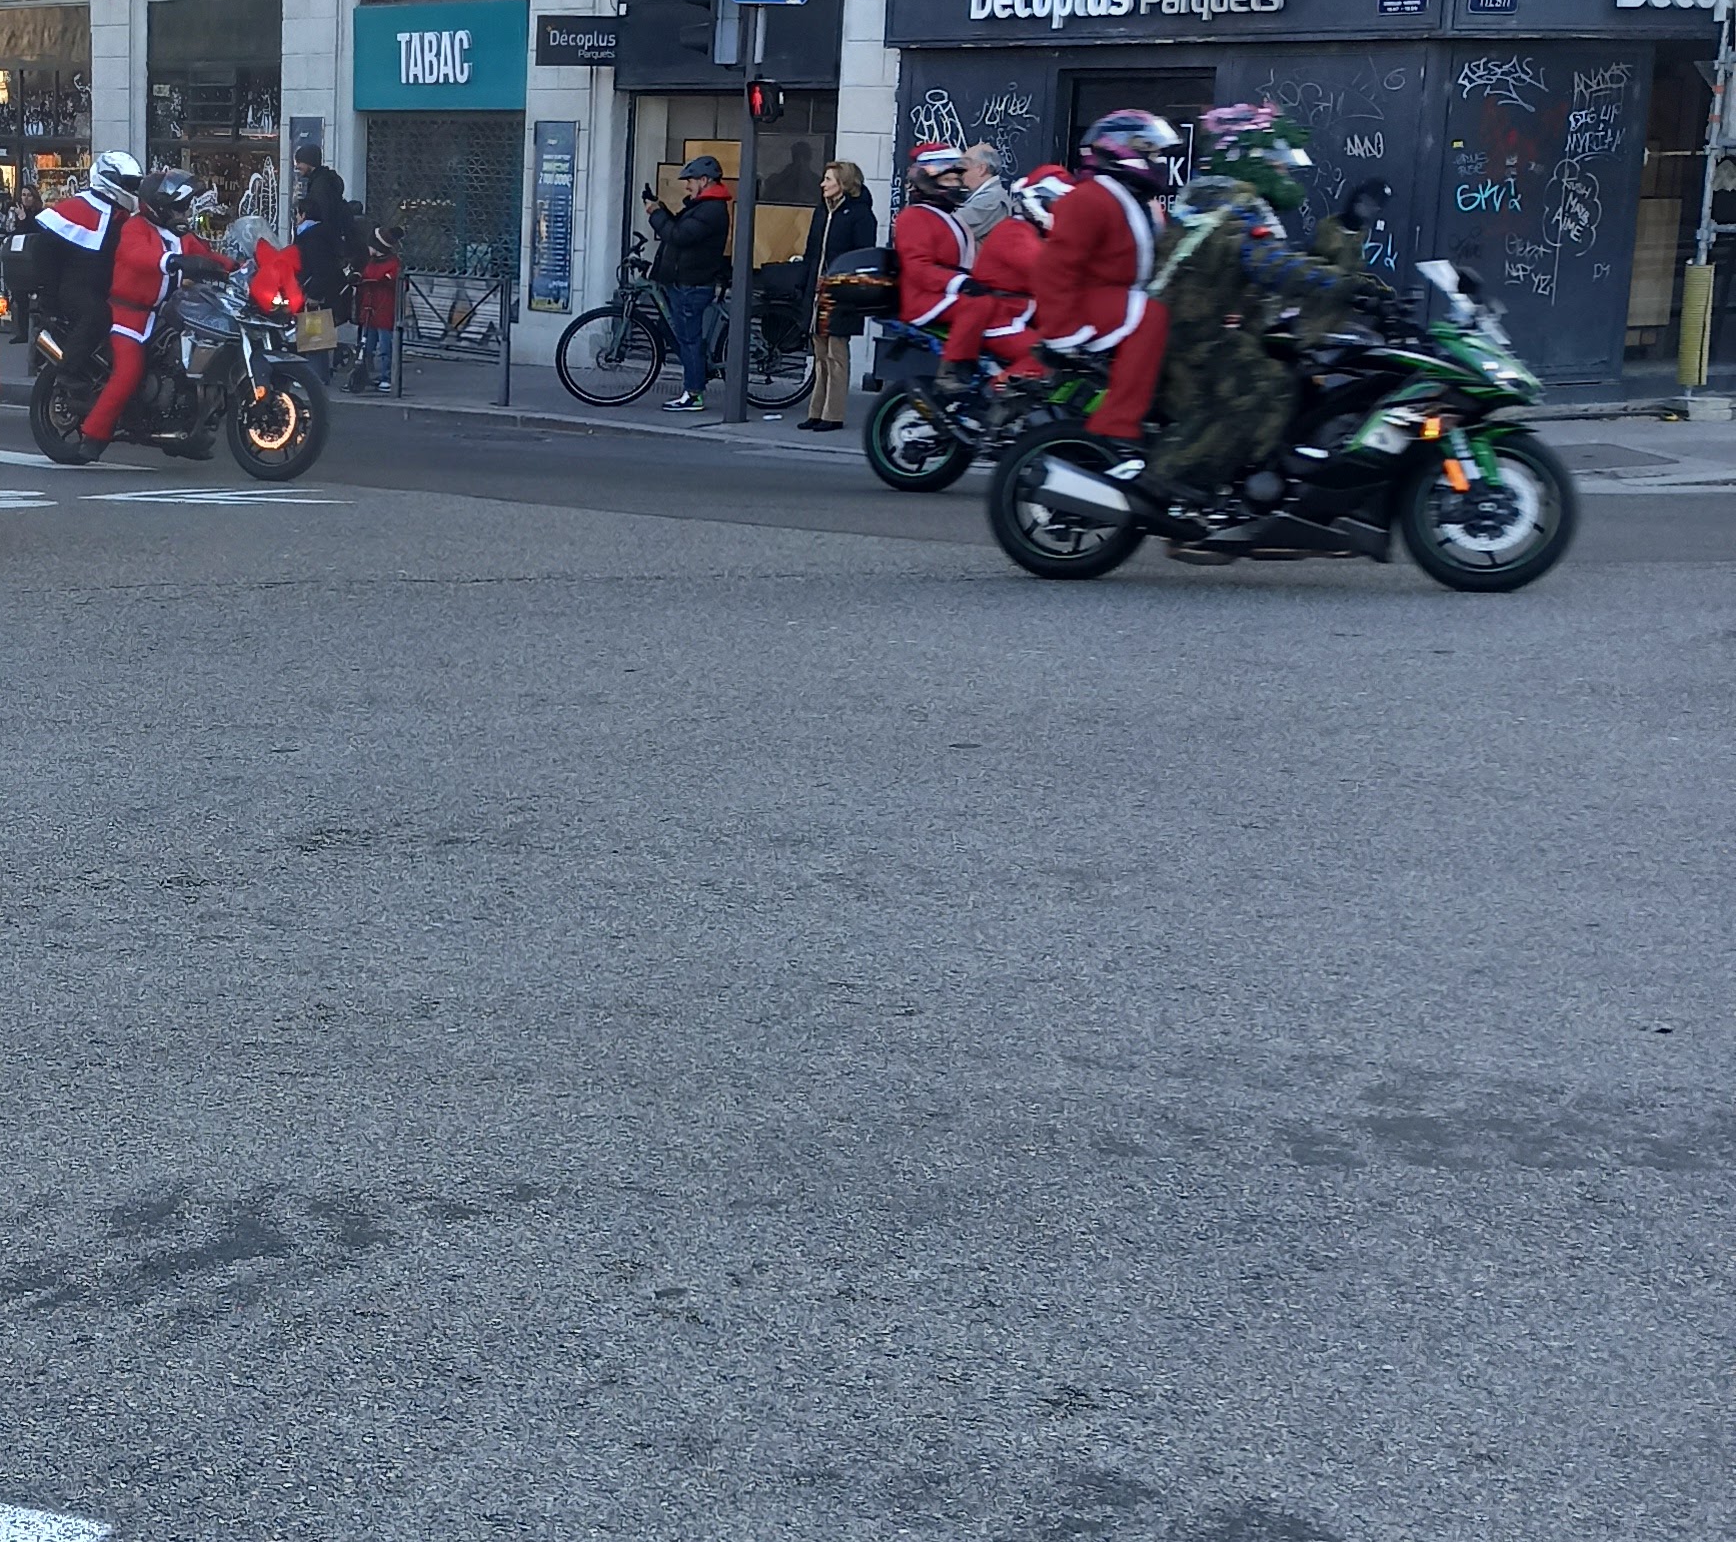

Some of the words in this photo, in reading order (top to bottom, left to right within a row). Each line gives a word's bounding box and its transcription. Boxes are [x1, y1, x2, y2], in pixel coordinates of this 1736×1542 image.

[549, 29, 616, 50] Décoplus
[396, 29, 473, 84] TABAC
[578, 49, 616, 60] Parquets
